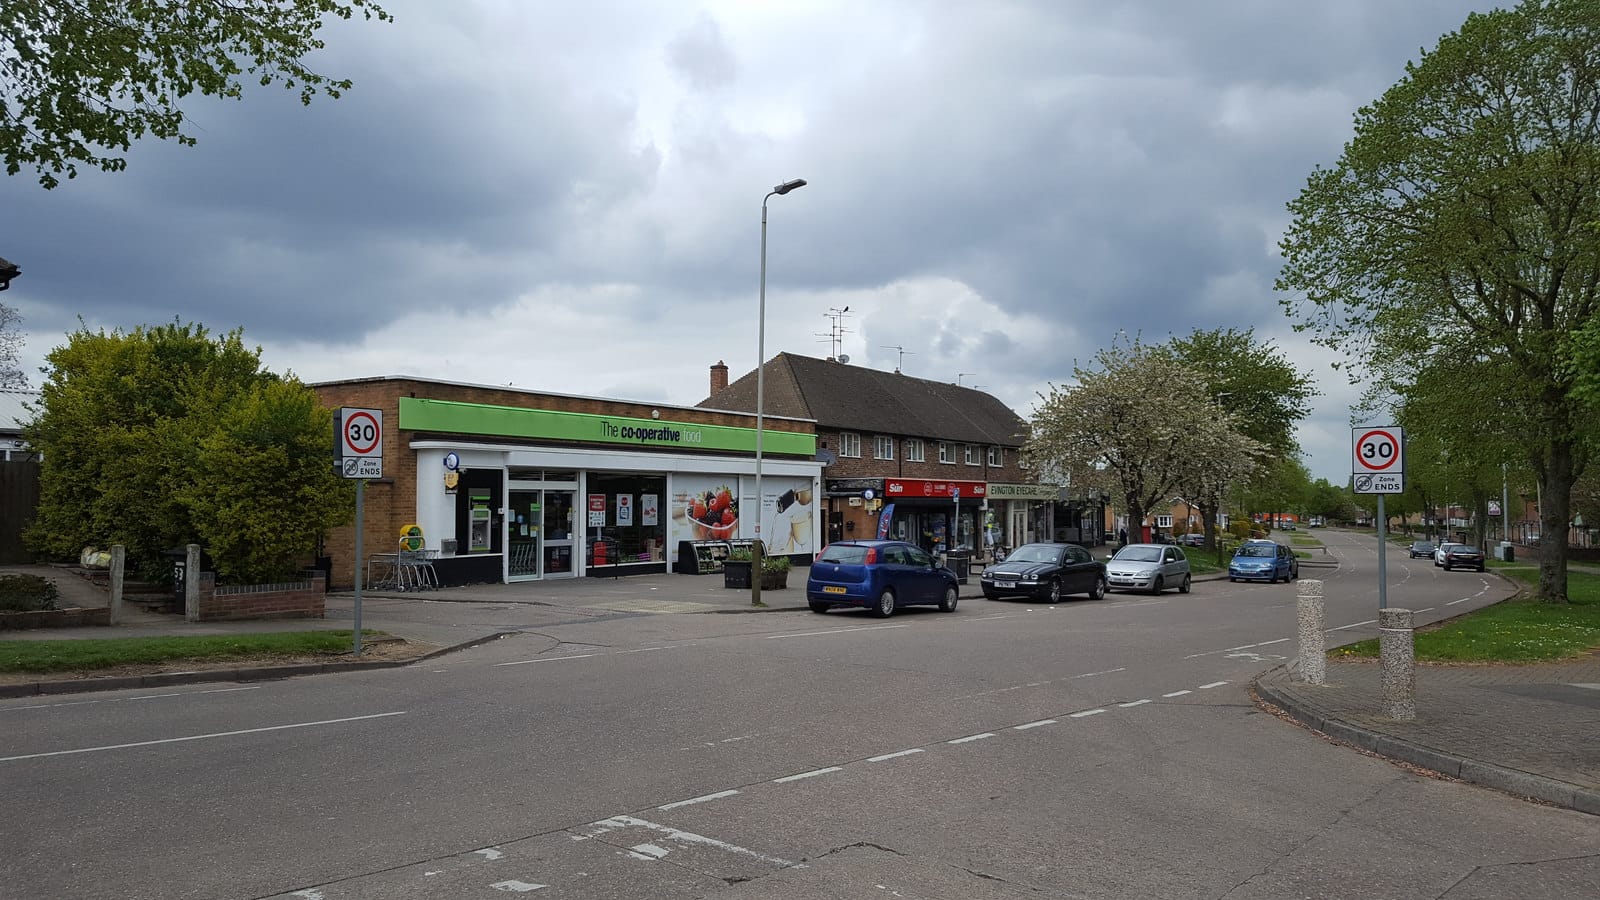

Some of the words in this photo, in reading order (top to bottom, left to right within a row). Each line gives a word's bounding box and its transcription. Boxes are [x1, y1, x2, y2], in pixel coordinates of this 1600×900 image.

[350, 424, 375, 441] 30
[601, 421, 618, 437] The
[683, 428, 702, 443] food
[1363, 442, 1392, 458] 30
[889, 483, 903, 493] Sun
[973, 485, 985, 494] Sun
[991, 485, 1015, 495] EVINGTON
